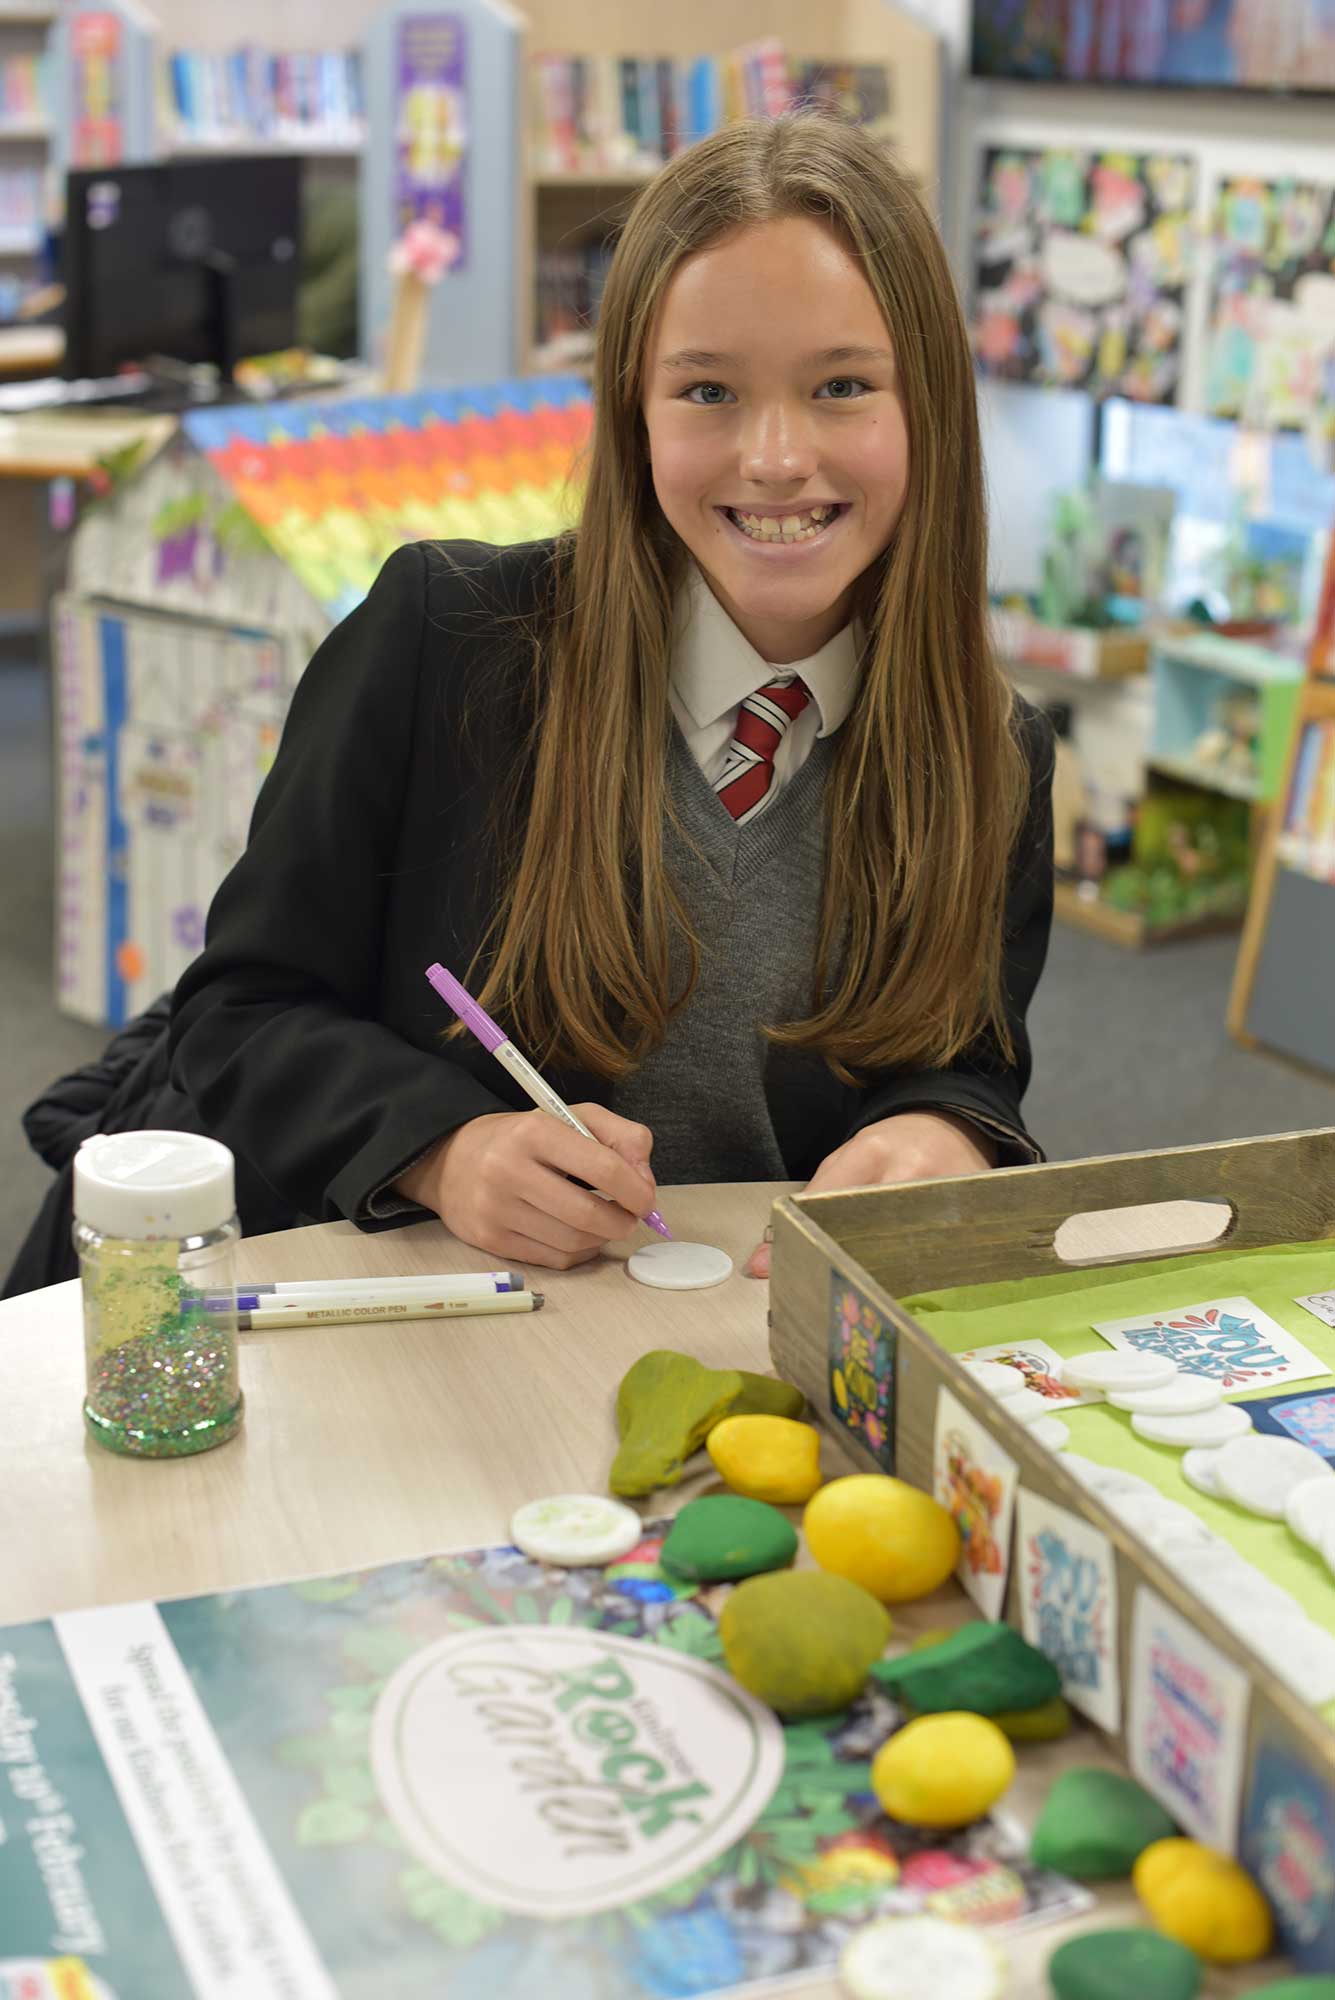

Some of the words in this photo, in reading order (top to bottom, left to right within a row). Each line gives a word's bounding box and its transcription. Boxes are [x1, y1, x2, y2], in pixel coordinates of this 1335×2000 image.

[307, 1308, 350, 1319] METALLIC
[353, 1306, 385, 1317] COLOR
[388, 1304, 407, 1314] PEN
[1161, 1326, 1205, 1356] ARE
[1188, 1313, 1291, 1368] YOU
[24, 1812, 108, 1954] February
